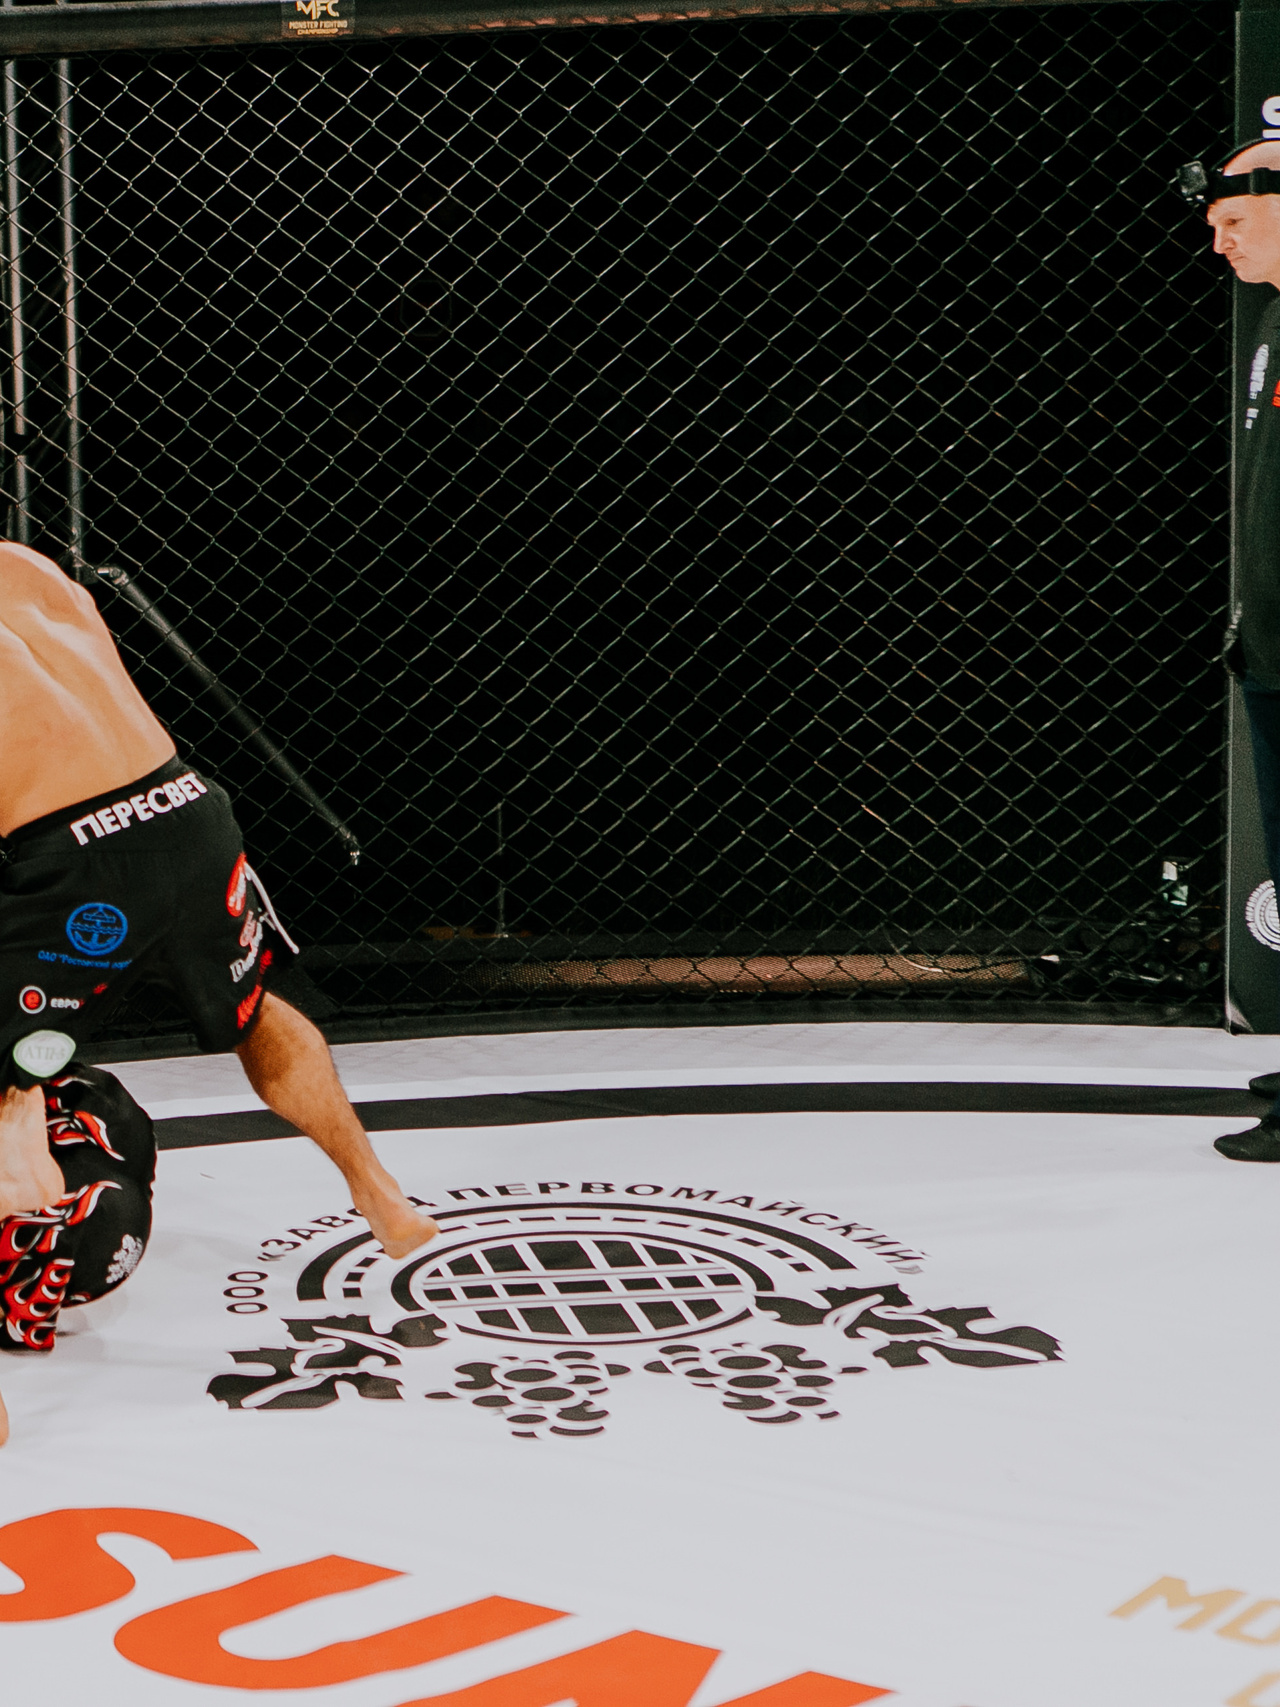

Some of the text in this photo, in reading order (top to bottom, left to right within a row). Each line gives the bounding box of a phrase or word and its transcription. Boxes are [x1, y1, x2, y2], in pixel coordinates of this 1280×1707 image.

[296, 0, 340, 20] MFC
[70, 771, 208, 846] ПЕРЕСВЕТ
[223, 1271, 269, 1314] ООО
[446, 1180, 933, 1275] ПЕРВОМАЙСКИЙ»
